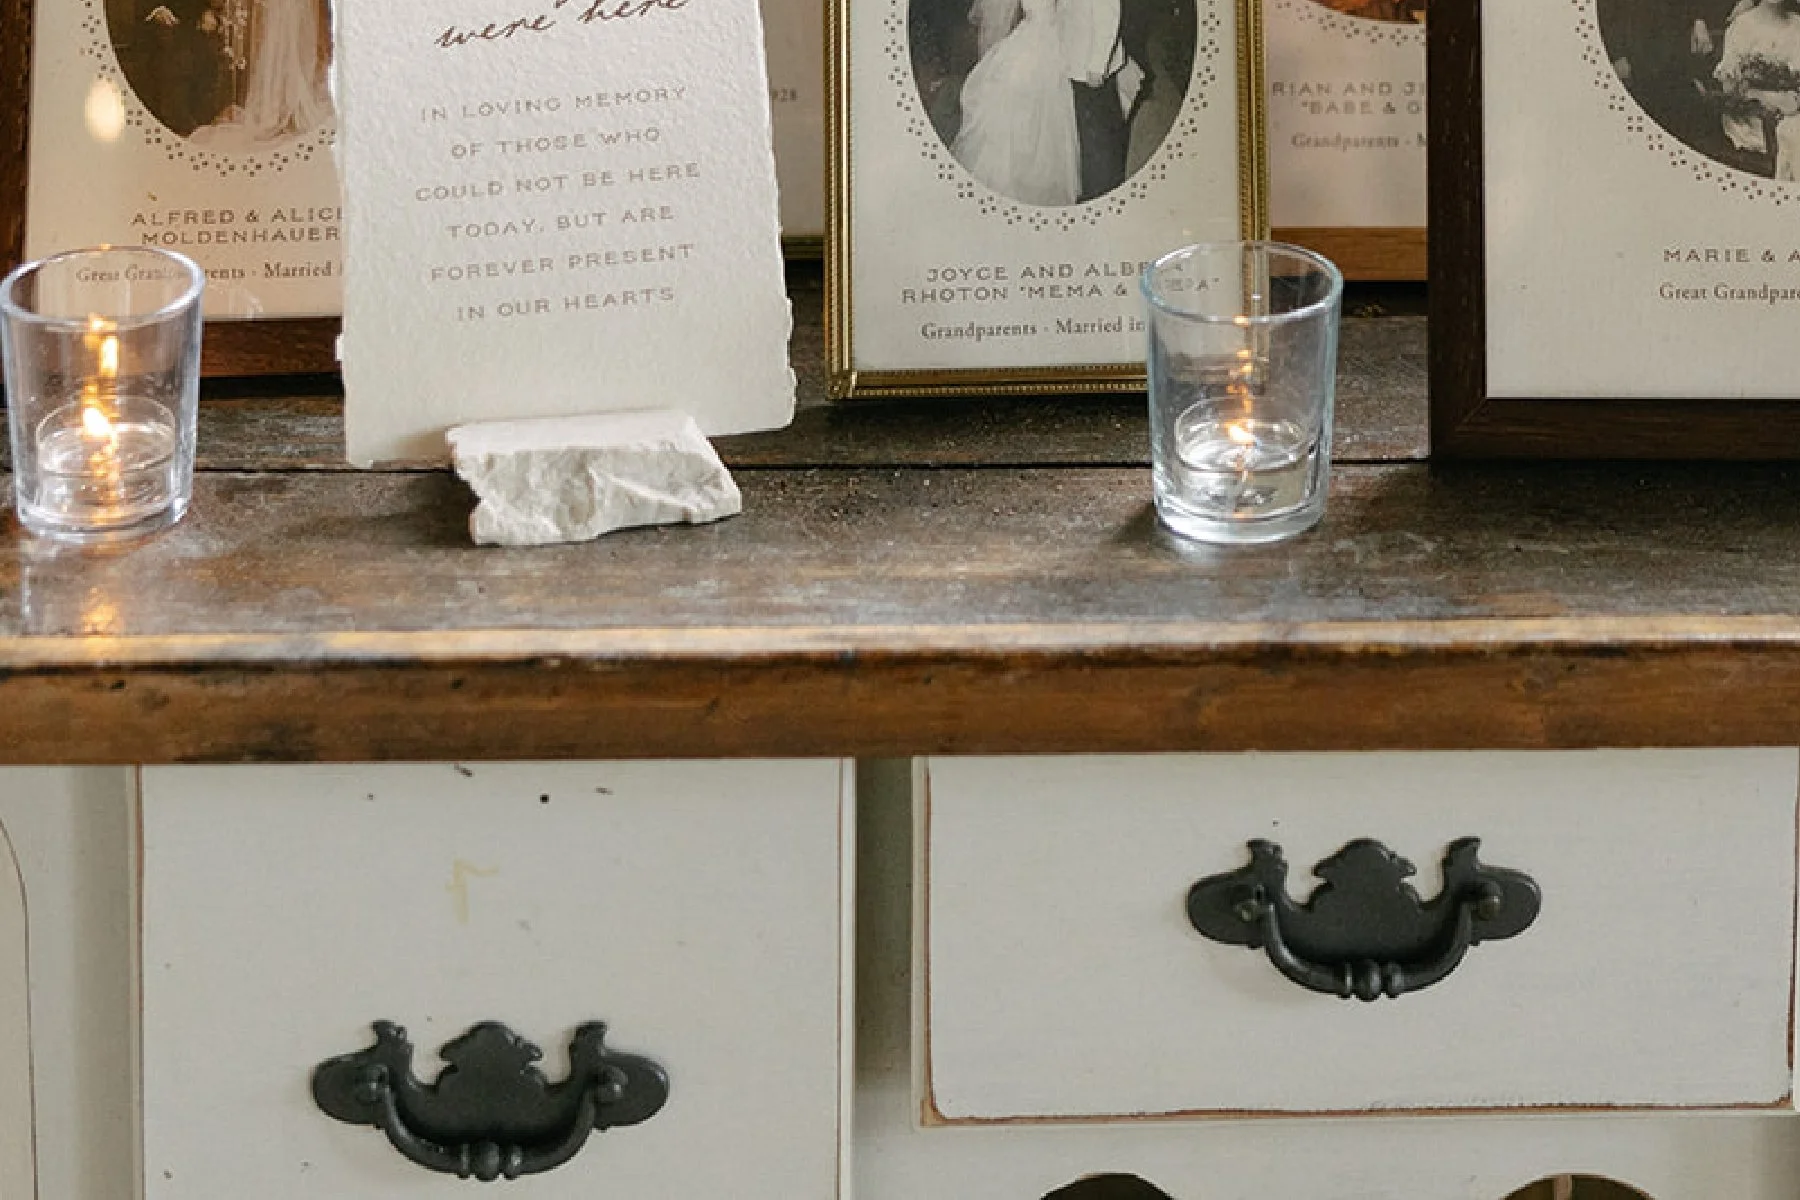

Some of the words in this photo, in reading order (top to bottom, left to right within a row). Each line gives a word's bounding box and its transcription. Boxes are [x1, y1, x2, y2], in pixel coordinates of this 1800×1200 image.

[434, 14, 556, 48] were
[1343, 81, 1393, 96] AND
[420, 105, 448, 122] IN
[462, 97, 561, 119] LOVING
[575, 86, 687, 111] MEMORY
[1383, 101, 1396, 115] &
[451, 142, 484, 159] OF
[497, 133, 587, 155] THOSE
[600, 127, 661, 146] WHO
[1291, 132, 1400, 152] Grandparents
[415, 180, 504, 202] COULD
[516, 176, 569, 194] NOT
[582, 171, 615, 188] BE
[628, 162, 700, 183] HERE
[132, 208, 235, 226] ALFRED
[246, 208, 260, 223] &
[447, 219, 545, 239] TODAY,
[557, 211, 608, 230] BUT
[621, 205, 675, 223] ARE
[141, 225, 341, 245] MOLDENHAUER
[431, 258, 554, 281] FOREVER
[568, 243, 695, 271] PRESENT
[1663, 248, 1750, 263] MARIE
[1761, 248, 1776, 263] &
[264, 260, 332, 278] Married
[926, 266, 1009, 282] JOYCE
[1020, 263, 1074, 279] AND
[901, 286, 1009, 303] RHOTON
[1113, 282, 1128, 296] &
[1659, 281, 1707, 299] Great
[457, 306, 485, 322] IN
[497, 299, 550, 318] OUR
[564, 287, 675, 312] HEARTS
[921, 321, 1038, 341] Grandparents
[1056, 316, 1123, 334] Married
